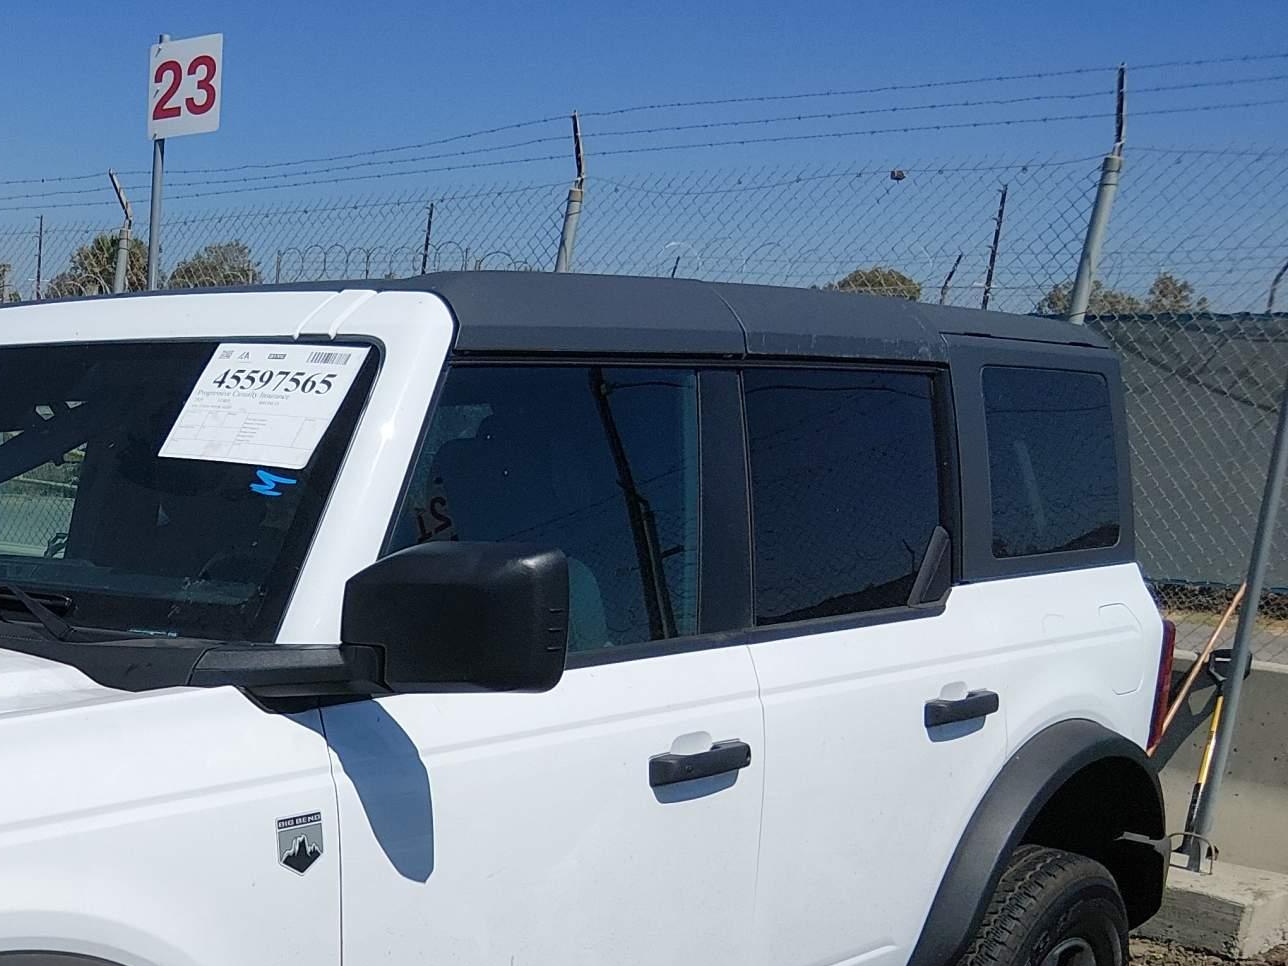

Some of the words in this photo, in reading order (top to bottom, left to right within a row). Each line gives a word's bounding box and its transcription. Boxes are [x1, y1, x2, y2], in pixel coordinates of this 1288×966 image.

[153, 55, 216, 120] 23
[213, 369, 337, 394] 45597565
[278, 819, 294, 828] BIG
[295, 814, 321, 825] BEND
